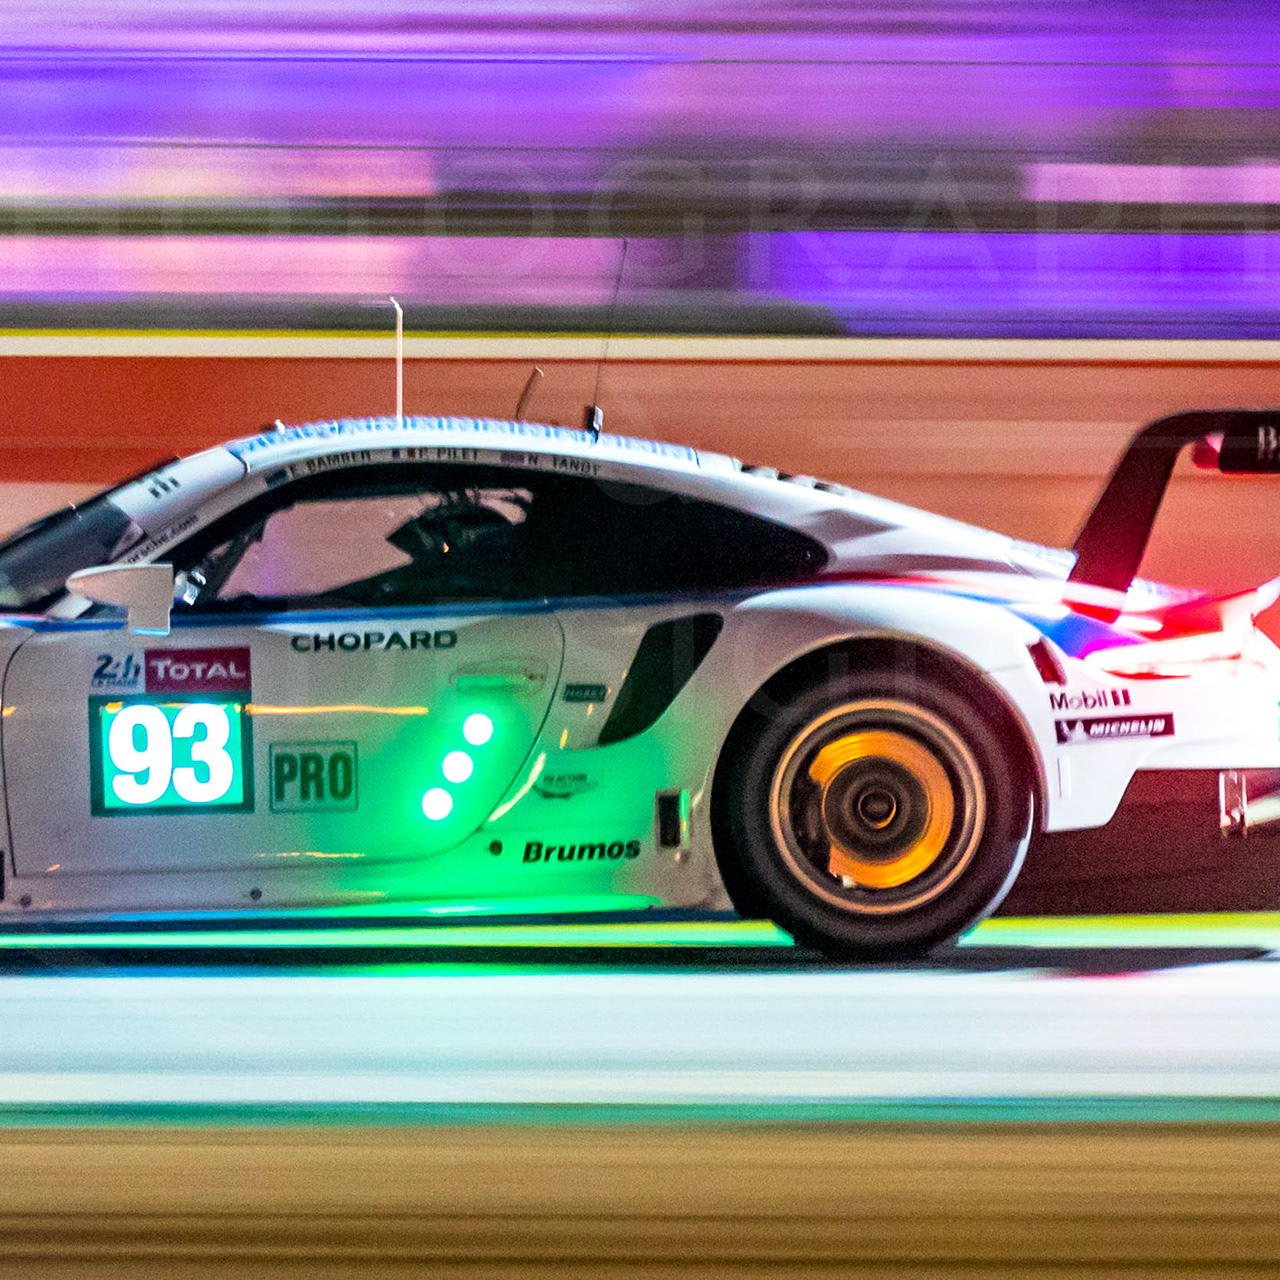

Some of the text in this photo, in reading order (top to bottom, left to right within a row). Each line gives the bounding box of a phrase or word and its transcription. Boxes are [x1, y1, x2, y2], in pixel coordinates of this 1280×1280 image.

[290, 630, 458, 653] CHOPARD
[149, 657, 246, 681] TOTAL
[1049, 689, 1108, 711] Mobil
[1089, 717, 1167, 737] MICHELIN
[108, 702, 234, 805] 93
[274, 750, 354, 802] PRO
[522, 839, 642, 864] Brumos
